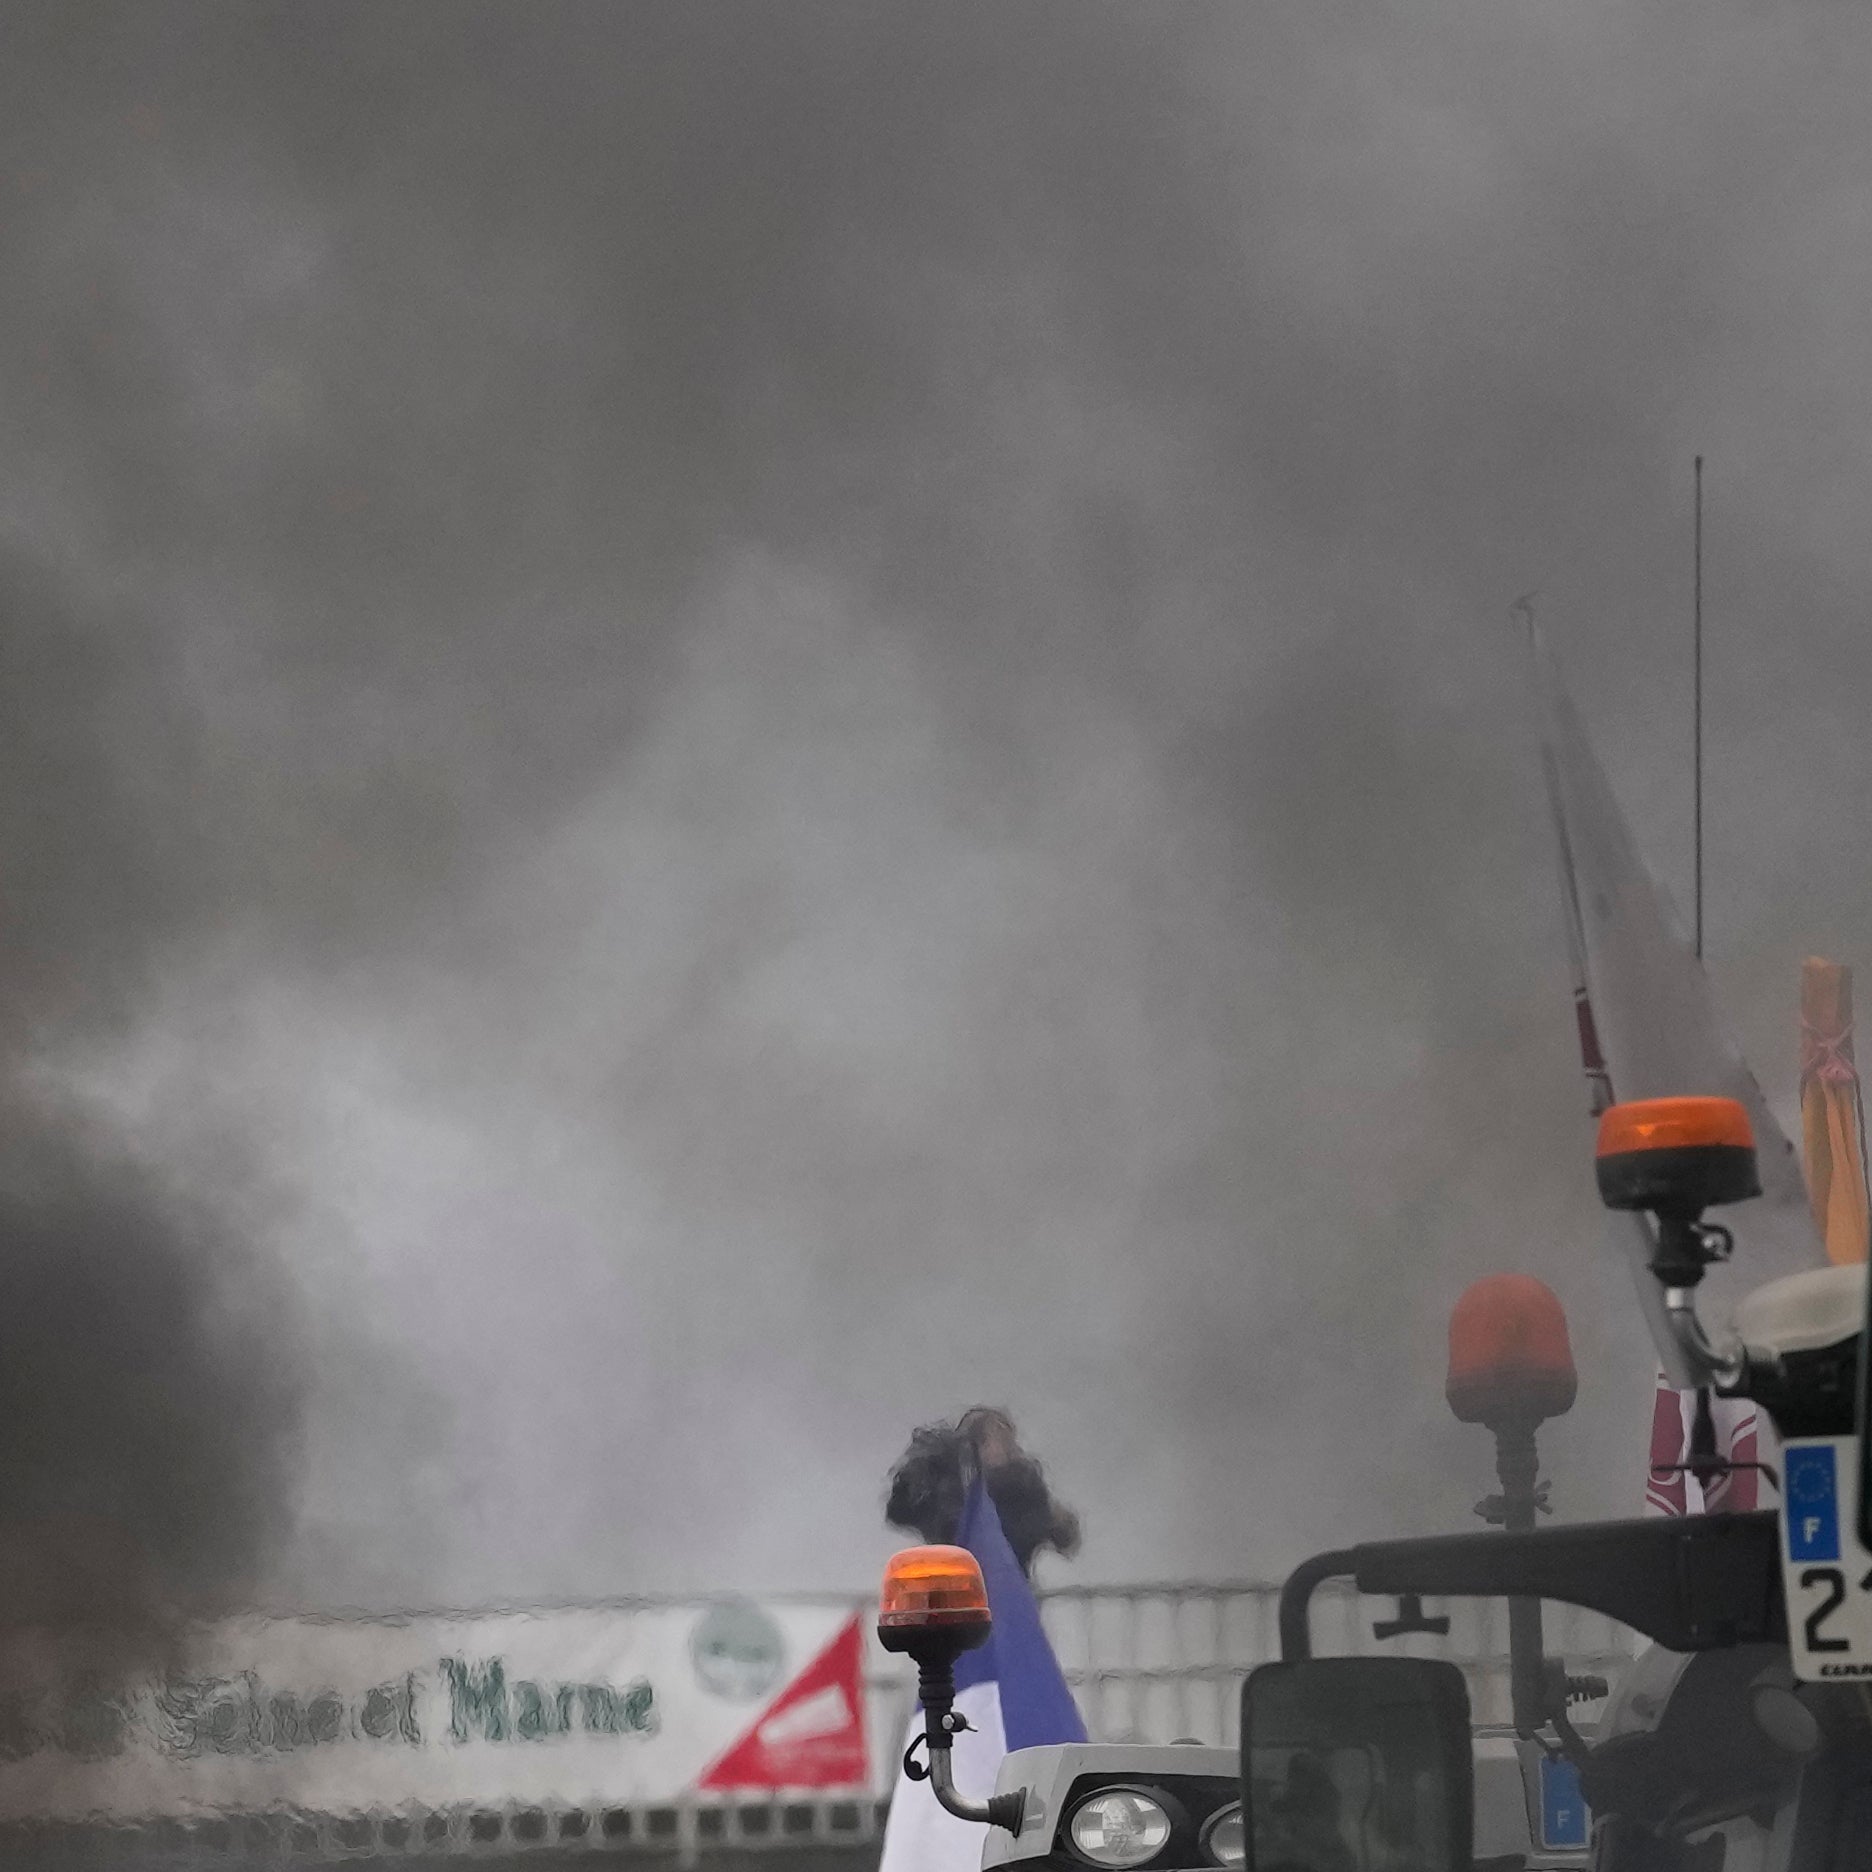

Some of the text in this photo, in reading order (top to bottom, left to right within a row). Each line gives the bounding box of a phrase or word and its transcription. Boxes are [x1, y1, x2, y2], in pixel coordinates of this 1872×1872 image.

[1801, 1516, 1822, 1545] F
[439, 1654, 655, 1743] Marne
[1556, 1809, 1571, 1830] F
